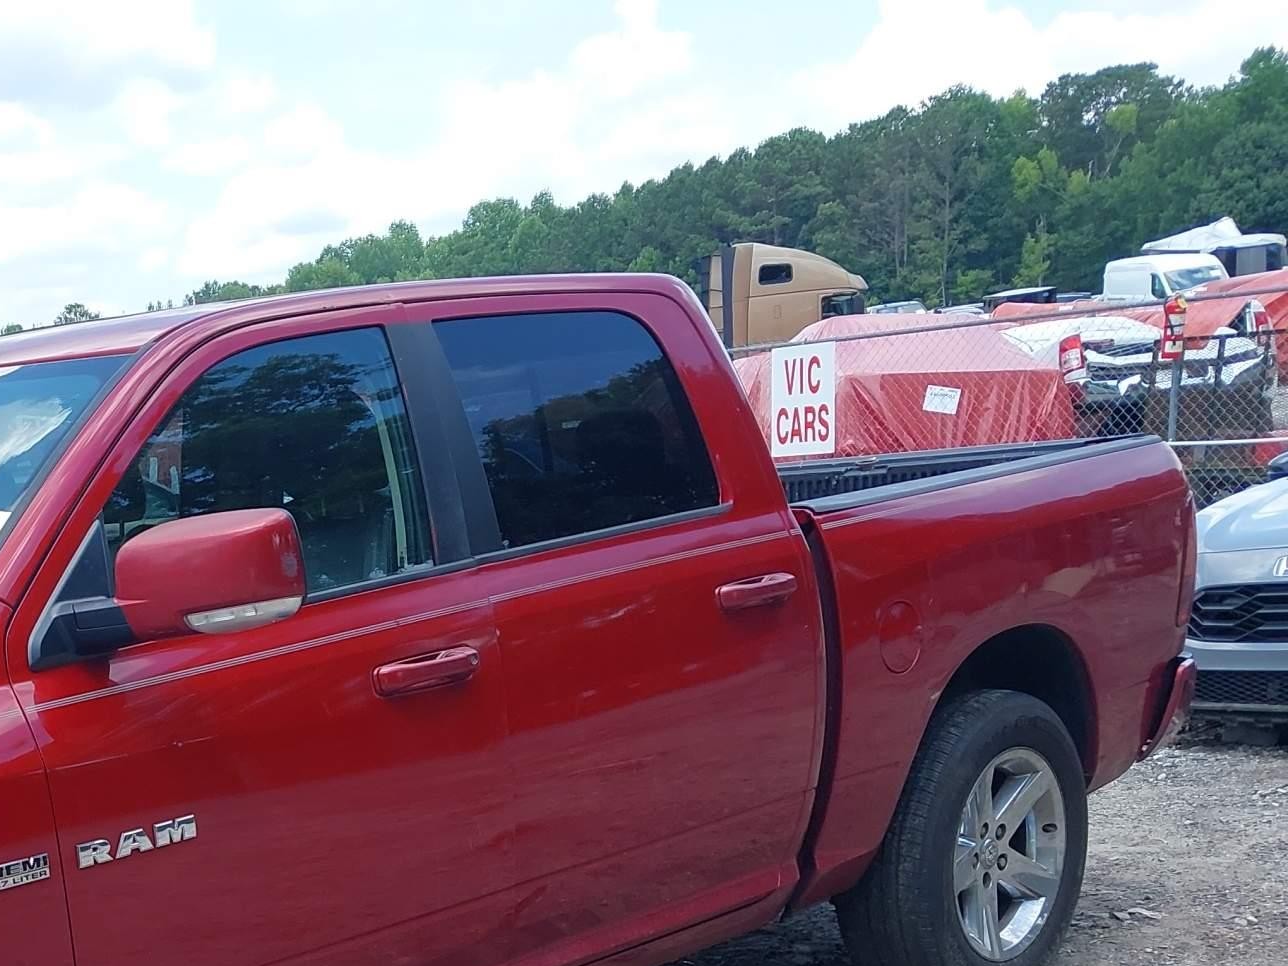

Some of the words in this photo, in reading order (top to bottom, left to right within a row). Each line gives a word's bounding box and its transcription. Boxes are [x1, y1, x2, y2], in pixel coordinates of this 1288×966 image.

[784, 355, 821, 395] VIC
[776, 403, 830, 445] CARS
[75, 813, 198, 870] RAM
[11, 869, 48, 886] LITER
